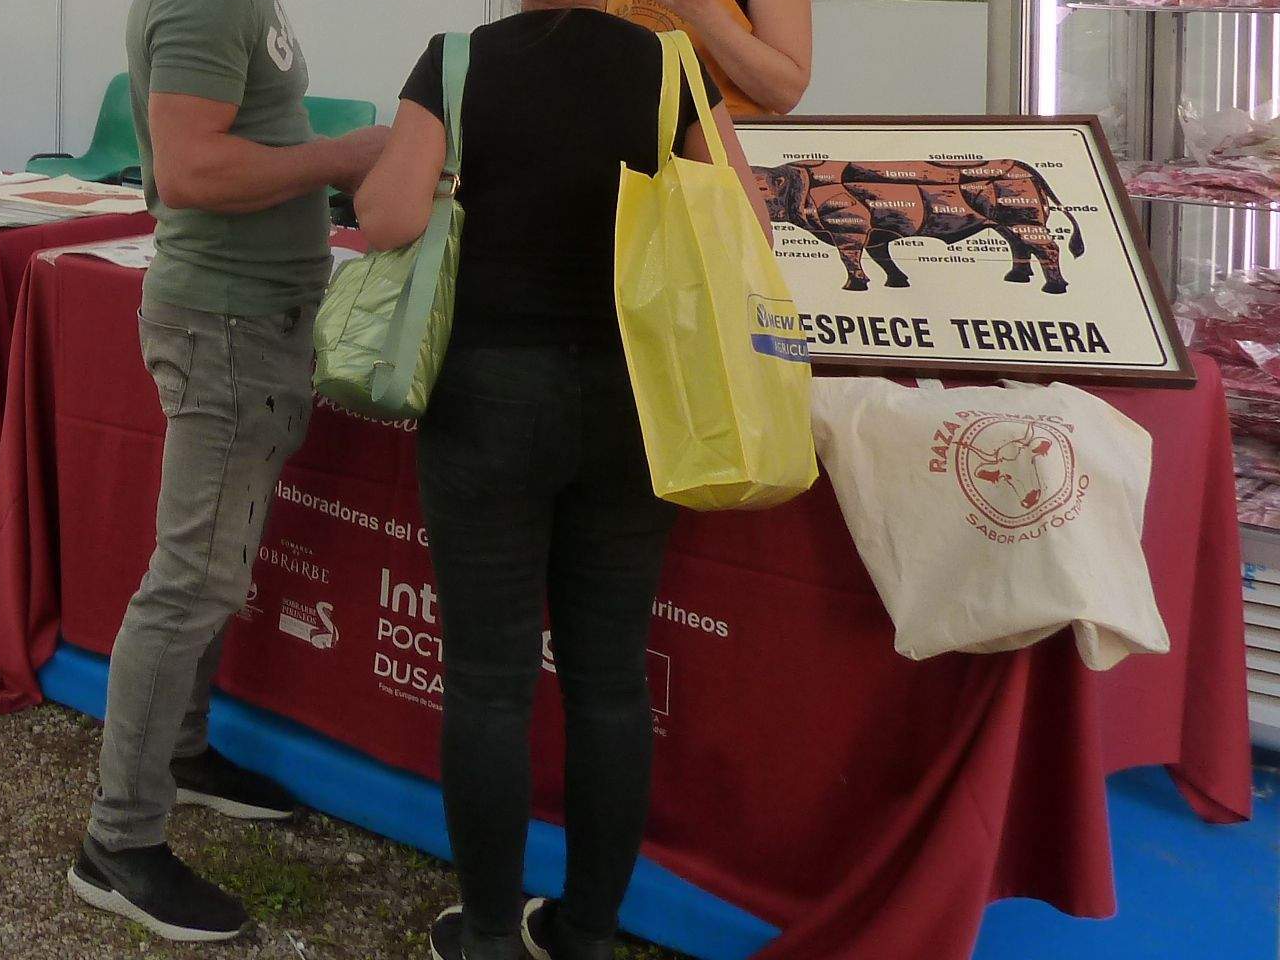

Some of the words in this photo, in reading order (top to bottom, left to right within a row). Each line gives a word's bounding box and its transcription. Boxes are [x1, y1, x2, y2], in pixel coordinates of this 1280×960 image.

[885, 170, 916, 178] lomo
[962, 166, 1003, 175] cadera
[869, 200, 916, 208] costillar
[998, 196, 1037, 205] contra
[932, 205, 965, 214] falda
[1054, 226, 1071, 234] de
[782, 238, 819, 246] pecho
[893, 239, 924, 247] aleta
[966, 238, 1007, 246] rabillo
[967, 245, 1009, 253] cadera
[775, 250, 829, 259] brazuelo
[918, 255, 976, 264] morcillos
[950, 318, 1111, 355] TERNERA
[929, 420, 961, 473] RAZA
[275, 480, 379, 531] laboradoras
[385, 518, 411, 541] del
[965, 513, 1015, 544] SABOR
